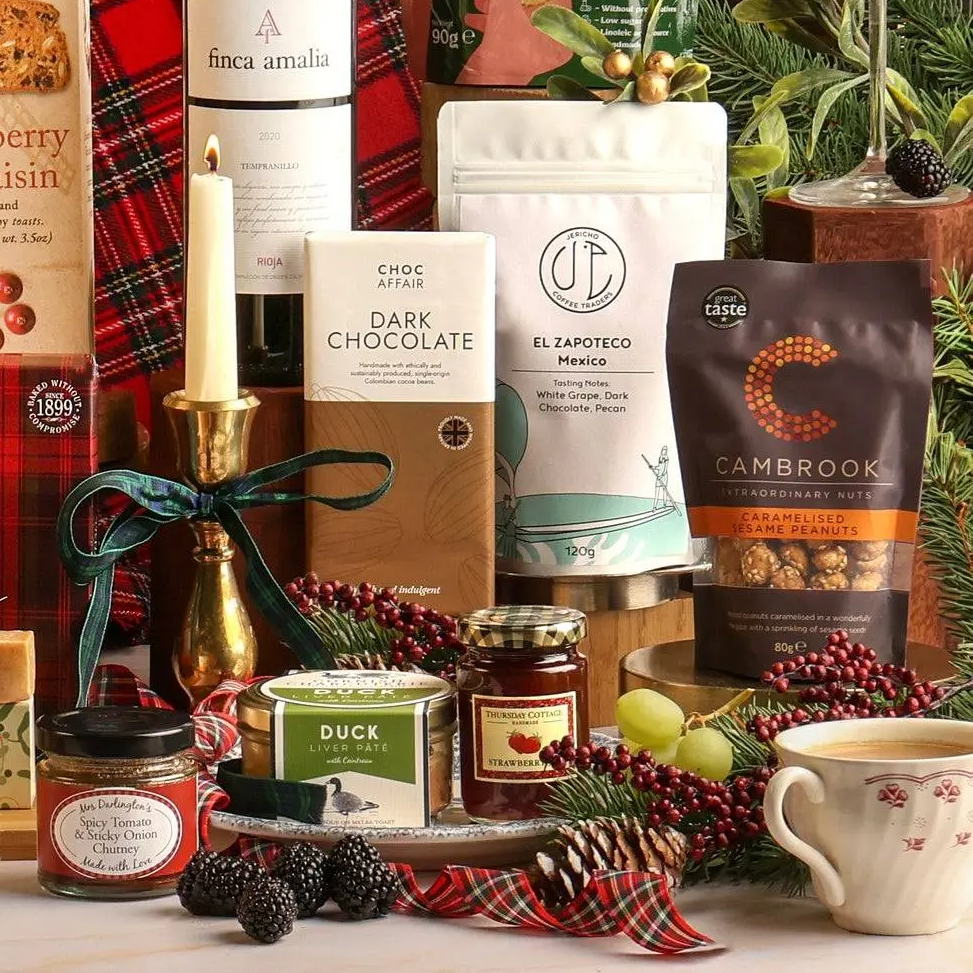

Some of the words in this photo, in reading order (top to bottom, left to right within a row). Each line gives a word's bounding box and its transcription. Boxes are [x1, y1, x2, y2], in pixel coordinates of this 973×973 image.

[208, 47, 254, 70] finca
[263, 47, 330, 70] amalia
[258, 131, 281, 141] 2020
[241, 162, 299, 171] TEMPRANILLO
[11, 217, 45, 228] toasts.
[2, 233, 18, 245] wt.
[20, 231, 53, 245] 3.5oz)
[566, 231, 600, 241] JERICHO
[378, 264, 424, 276] CHOC
[377, 278, 424, 289] AFFAIR
[552, 290, 579, 310] COFFEE
[580, 290, 614, 310] TRADERS
[705, 303, 747, 316] taste
[370, 311, 432, 329] DARK
[327, 331, 474, 351] CHOCOLATE
[533, 337, 550, 348] EL
[554, 337, 632, 349] ZAPOTECO
[558, 354, 607, 367] Mexico
[553, 379, 582, 389] Tasting
[585, 379, 611, 388] Notes:
[27, 381, 48, 407] BAKED
[51, 379, 82, 408] WITHOUT
[536, 390, 566, 401] White
[568, 391, 602, 403] Grape,
[604, 391, 629, 400] Dark
[37, 398, 73, 416] 1899
[538, 403, 593, 414] Chocolate,
[595, 404, 626, 413] Pecan
[29, 413, 80, 434] COMPROMISE
[716, 456, 880, 479] CAMBROOK
[837, 490, 873, 500] NUTS
[741, 512, 845, 524] CARAMELISED
[732, 524, 784, 534] SESAME
[791, 525, 859, 536] PEANUTS
[565, 546, 595, 559] 120g
[398, 585, 441, 597] indulgent
[774, 642, 794, 655] 80g
[486, 710, 526, 719] THURSDAY
[528, 709, 563, 718] COTTAGE
[320, 724, 379, 740] DUCK
[309, 744, 349, 752] LIVER
[356, 741, 388, 752] PÂTÉ
[489, 758, 551, 768] STRAWBERR
[79, 802, 97, 814] Mrs
[98, 797, 152, 813] Darlington's
[80, 816, 108, 830] Spicy
[110, 816, 152, 827] Tomato
[74, 830, 87, 840] &
[87, 830, 121, 844] Sticky
[123, 830, 158, 841] Onion
[92, 842, 140, 857] Chutney
[80, 857, 107, 872] Made
[108, 860, 131, 872] with
[133, 857, 153, 870] Love
